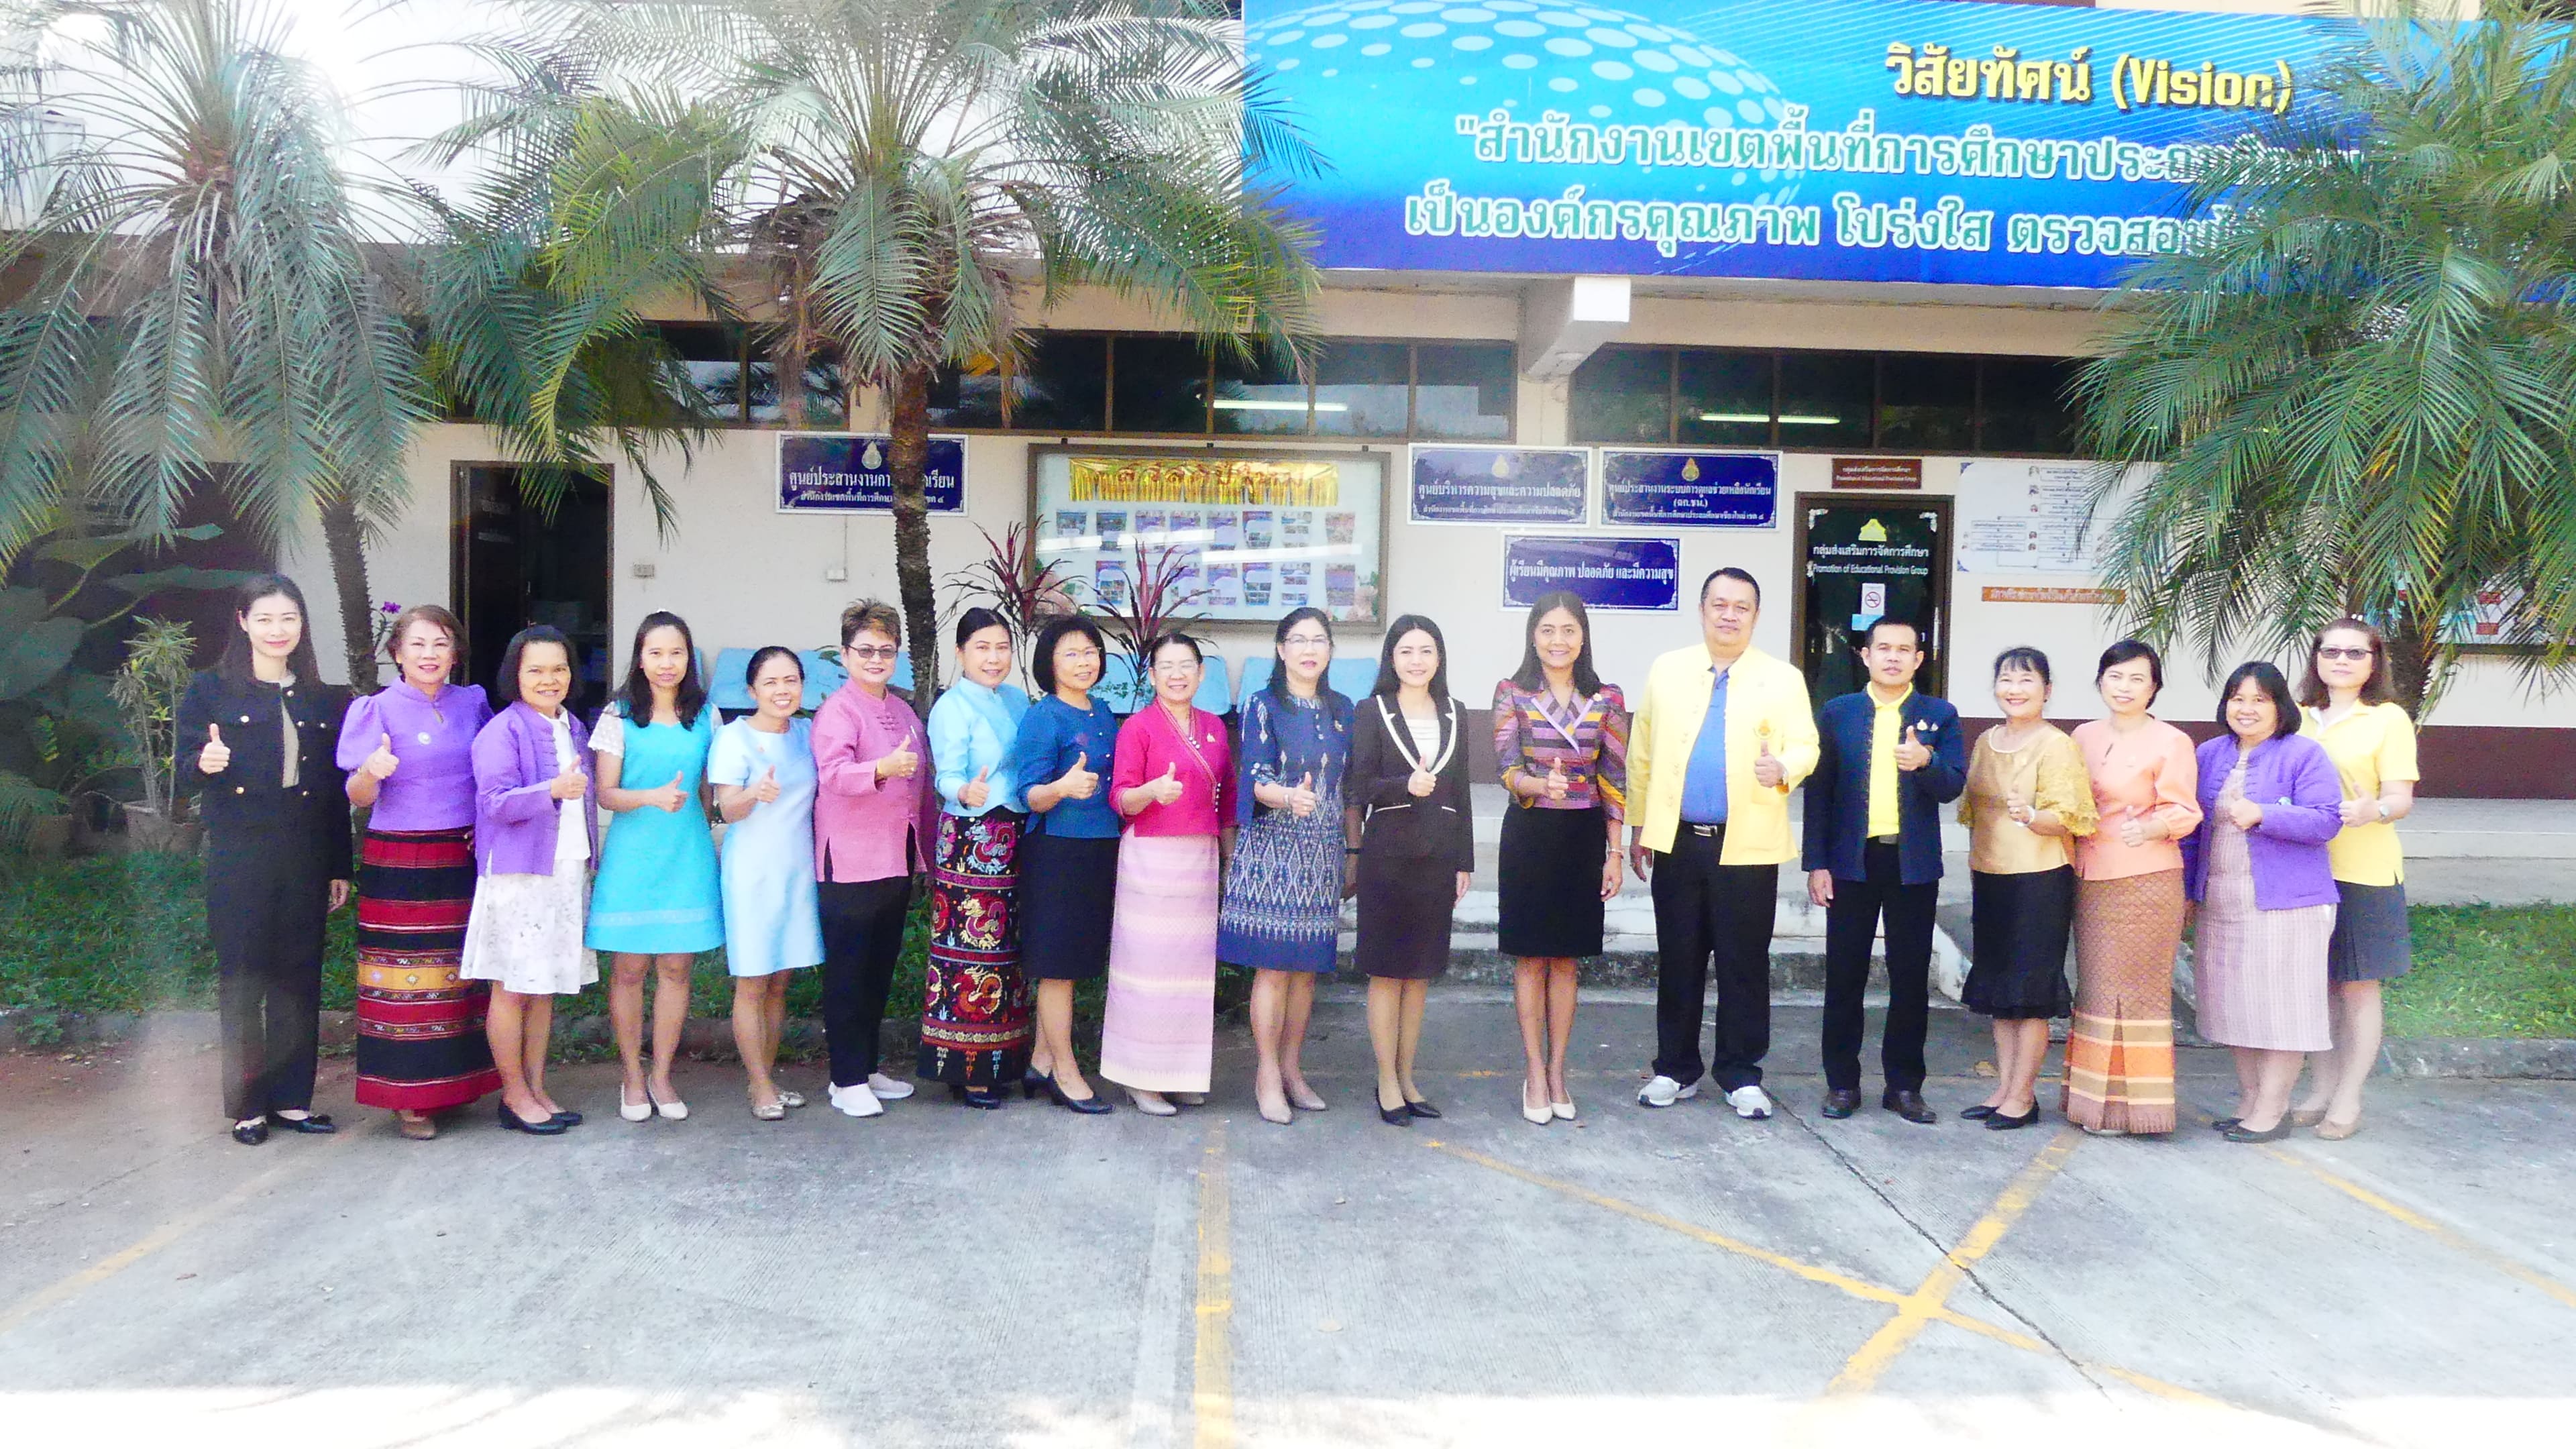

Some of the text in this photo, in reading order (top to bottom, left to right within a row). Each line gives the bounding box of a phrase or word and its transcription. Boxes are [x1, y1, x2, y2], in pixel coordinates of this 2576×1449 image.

[1886, 42, 2292, 115] วิสัยทัศน์ (Vision)
[1406, 178, 1819, 257] เป็นองค์กรคุณภาพ
[1834, 192, 1993, 253] โปร่งใส
[1578, 561, 1614, 579] ปลอดภัย
